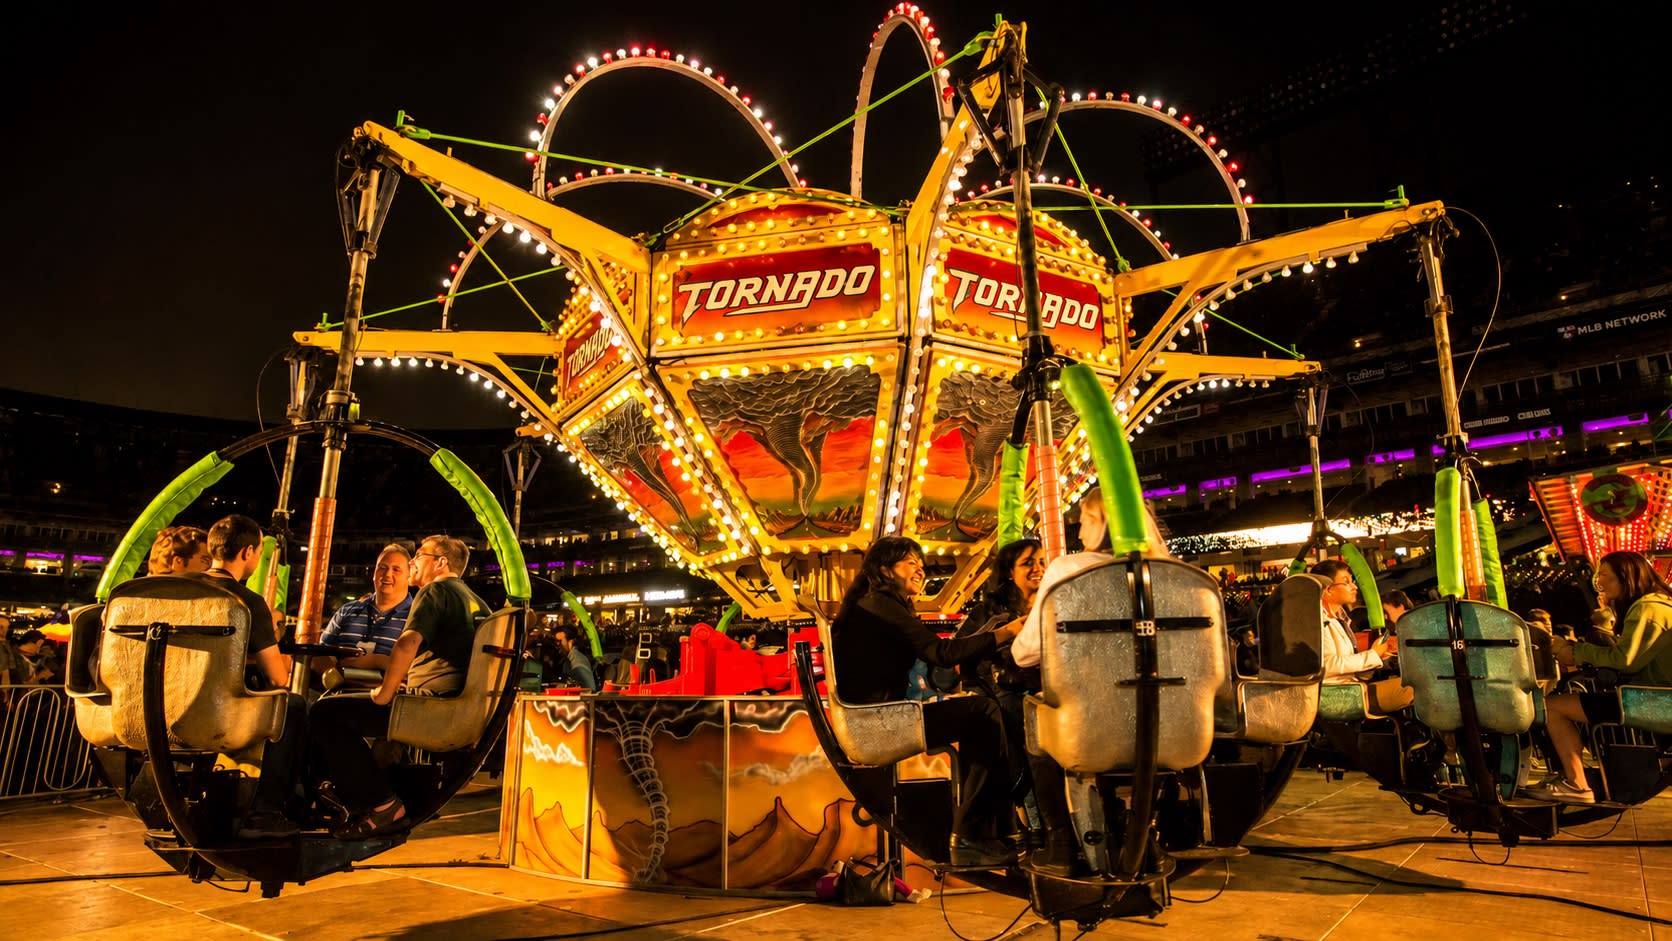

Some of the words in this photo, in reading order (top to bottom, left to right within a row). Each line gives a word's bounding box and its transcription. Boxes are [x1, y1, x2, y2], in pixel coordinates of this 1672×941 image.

[679, 264, 876, 324] TORNADO
[1577, 322, 1603, 335] MLB
[1605, 309, 1667, 330] NETWORK
[1451, 640, 1464, 650] 16
